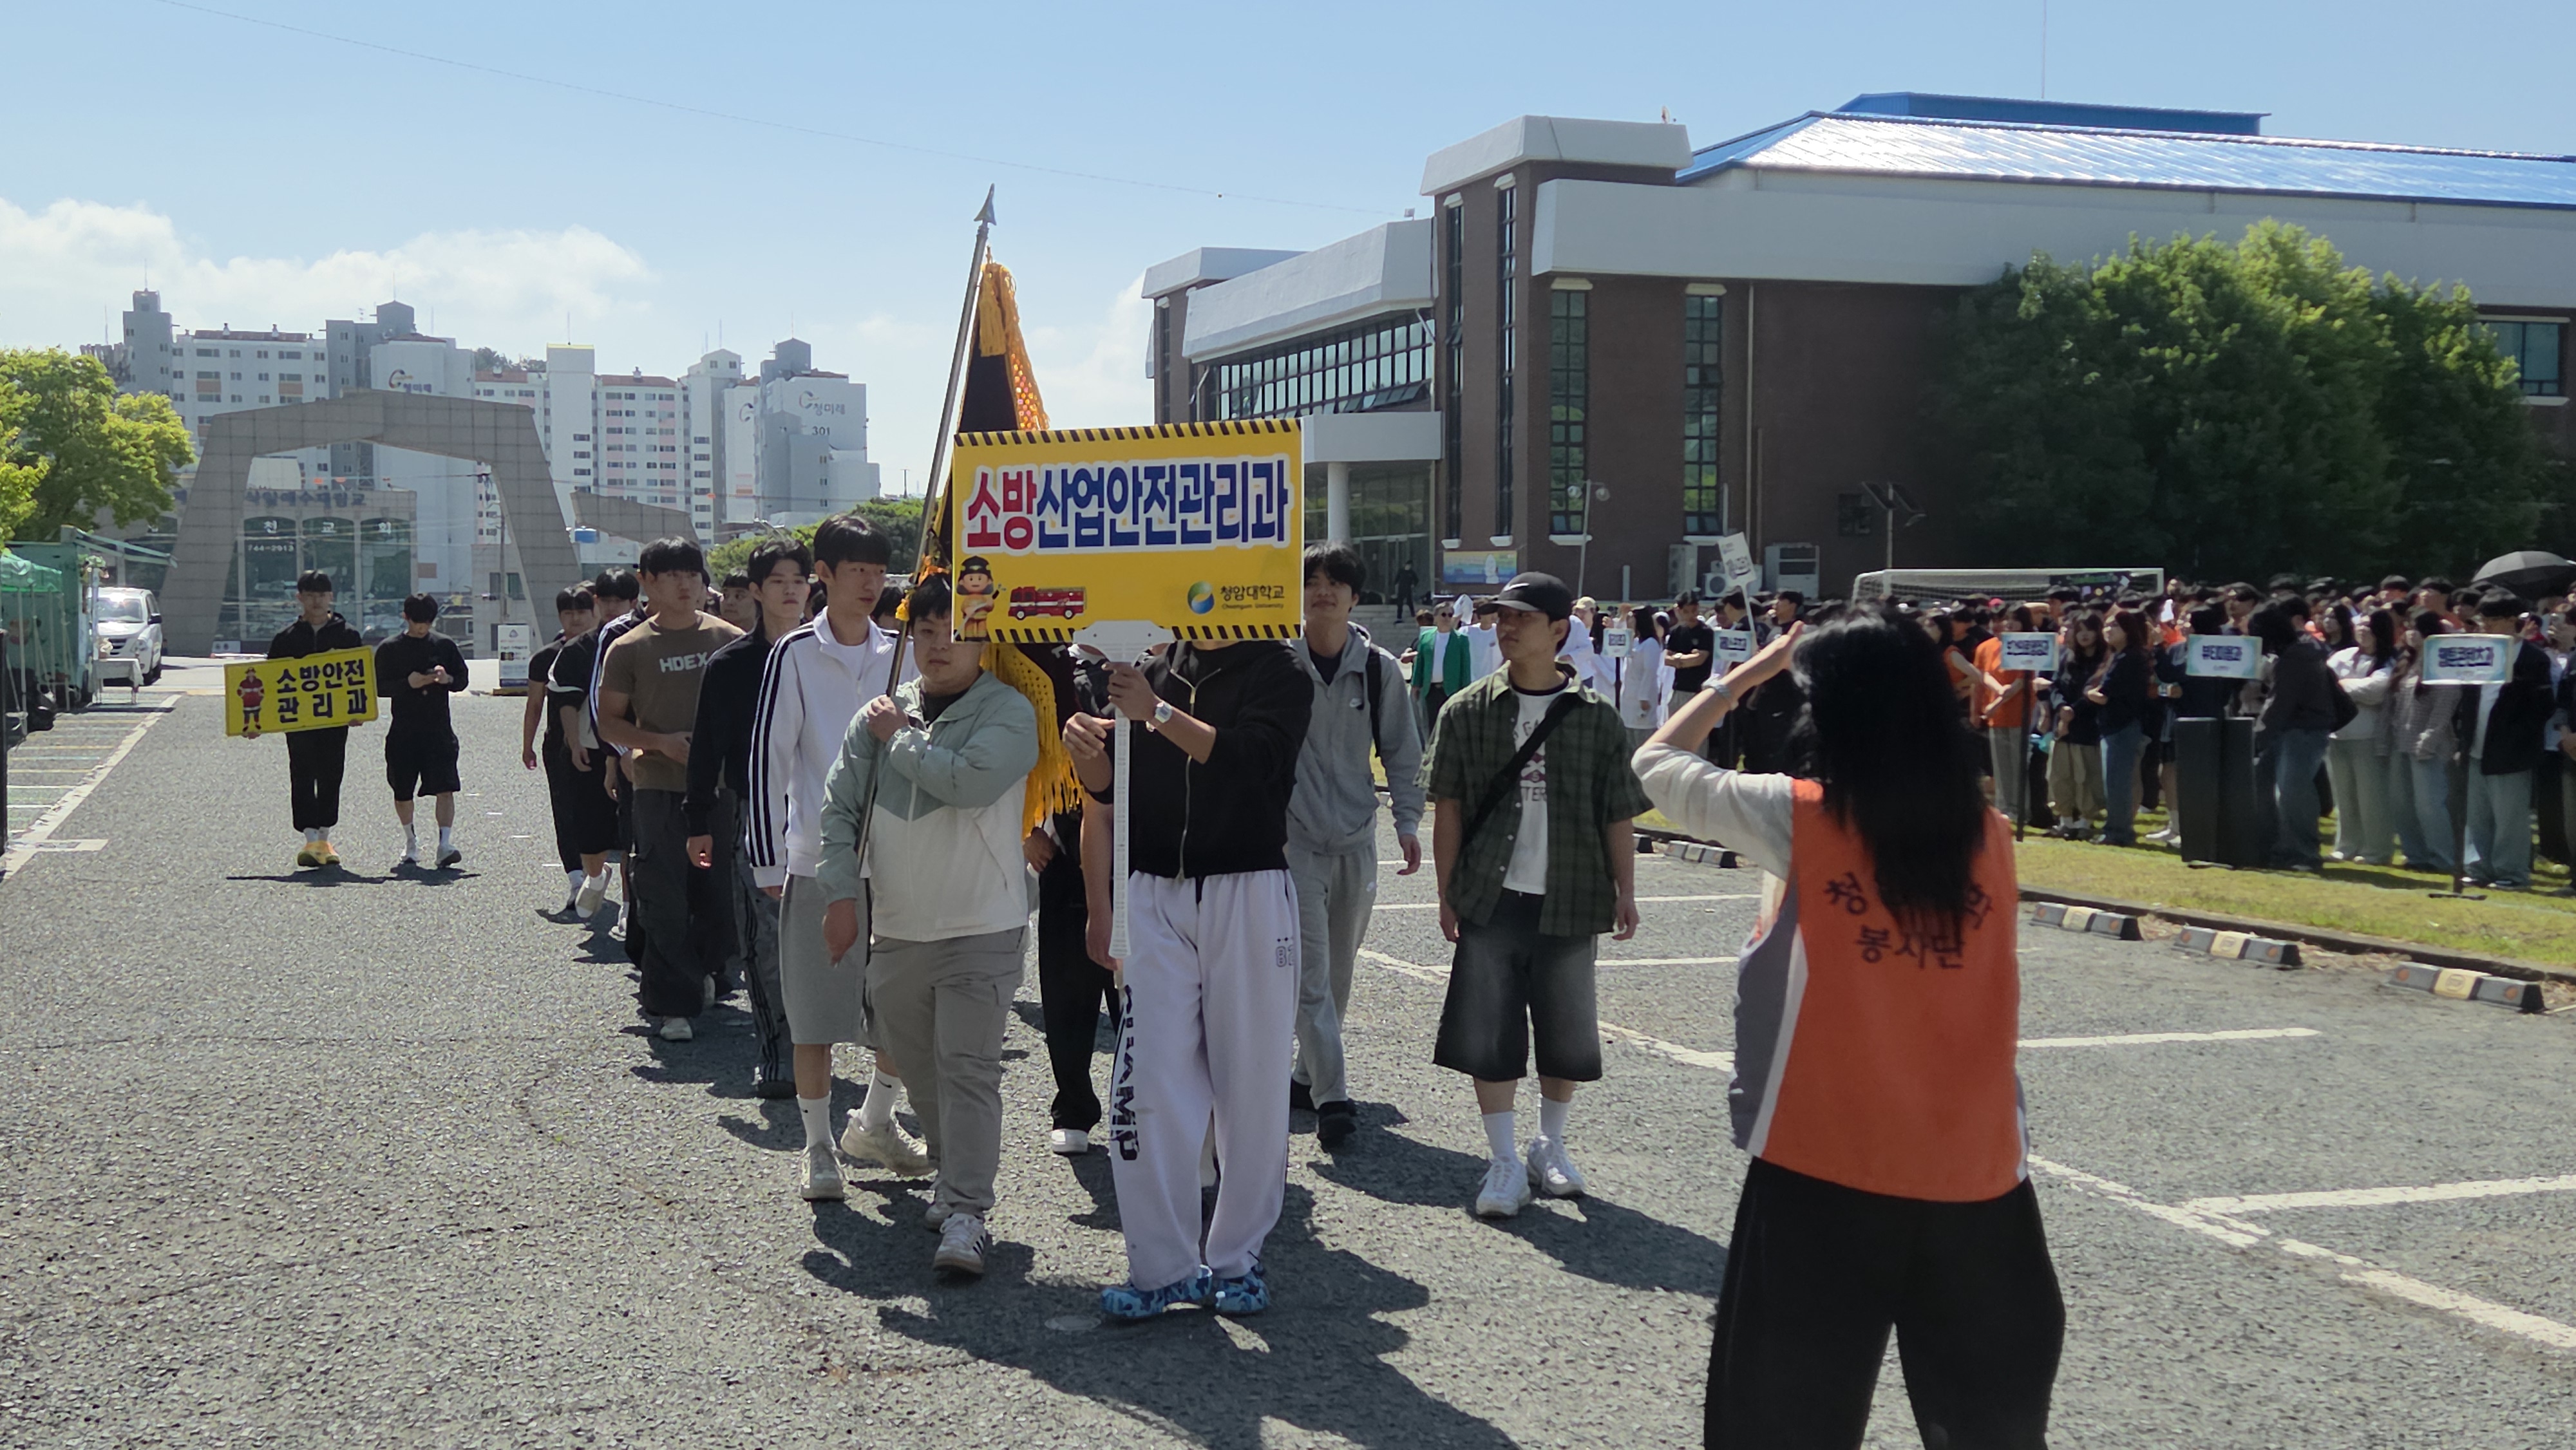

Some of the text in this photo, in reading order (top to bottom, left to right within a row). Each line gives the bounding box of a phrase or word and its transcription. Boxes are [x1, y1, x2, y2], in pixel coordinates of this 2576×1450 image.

[812, 426, 830, 436] 301
[966, 459, 1289, 550] 소방산업안전관리과
[1220, 585, 1285, 601] 청암대학교
[659, 652, 708, 673] HDEX
[276, 659, 365, 693] 소방안전
